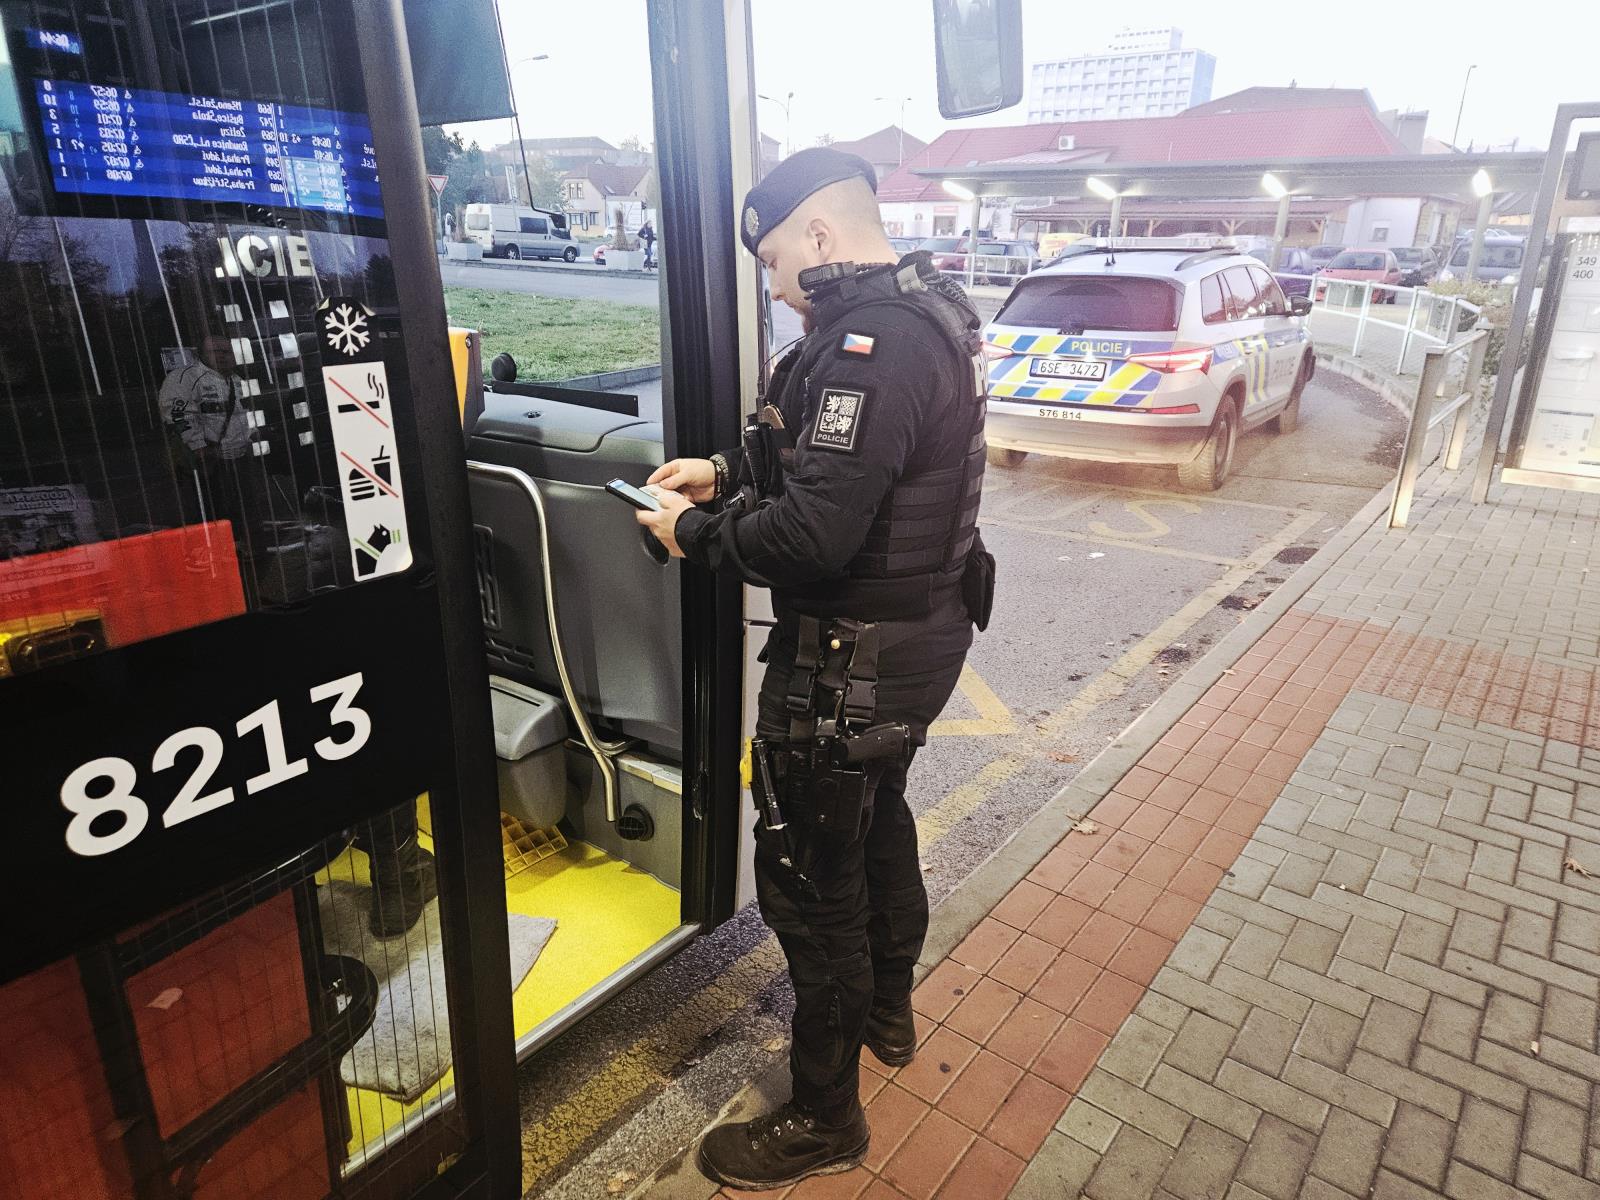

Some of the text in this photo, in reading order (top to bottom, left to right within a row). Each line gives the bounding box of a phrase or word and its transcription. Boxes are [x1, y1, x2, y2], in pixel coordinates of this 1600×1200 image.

[1576, 256, 1597, 266] 349
[1573, 269, 1593, 279] 400
[1071, 341, 1123, 353] POLICIE
[1040, 362, 1099, 377] 6SE 3472
[1039, 408, 1082, 421] S76 814
[817, 433, 849, 444] POLICIE
[60, 671, 372, 857] 8213
